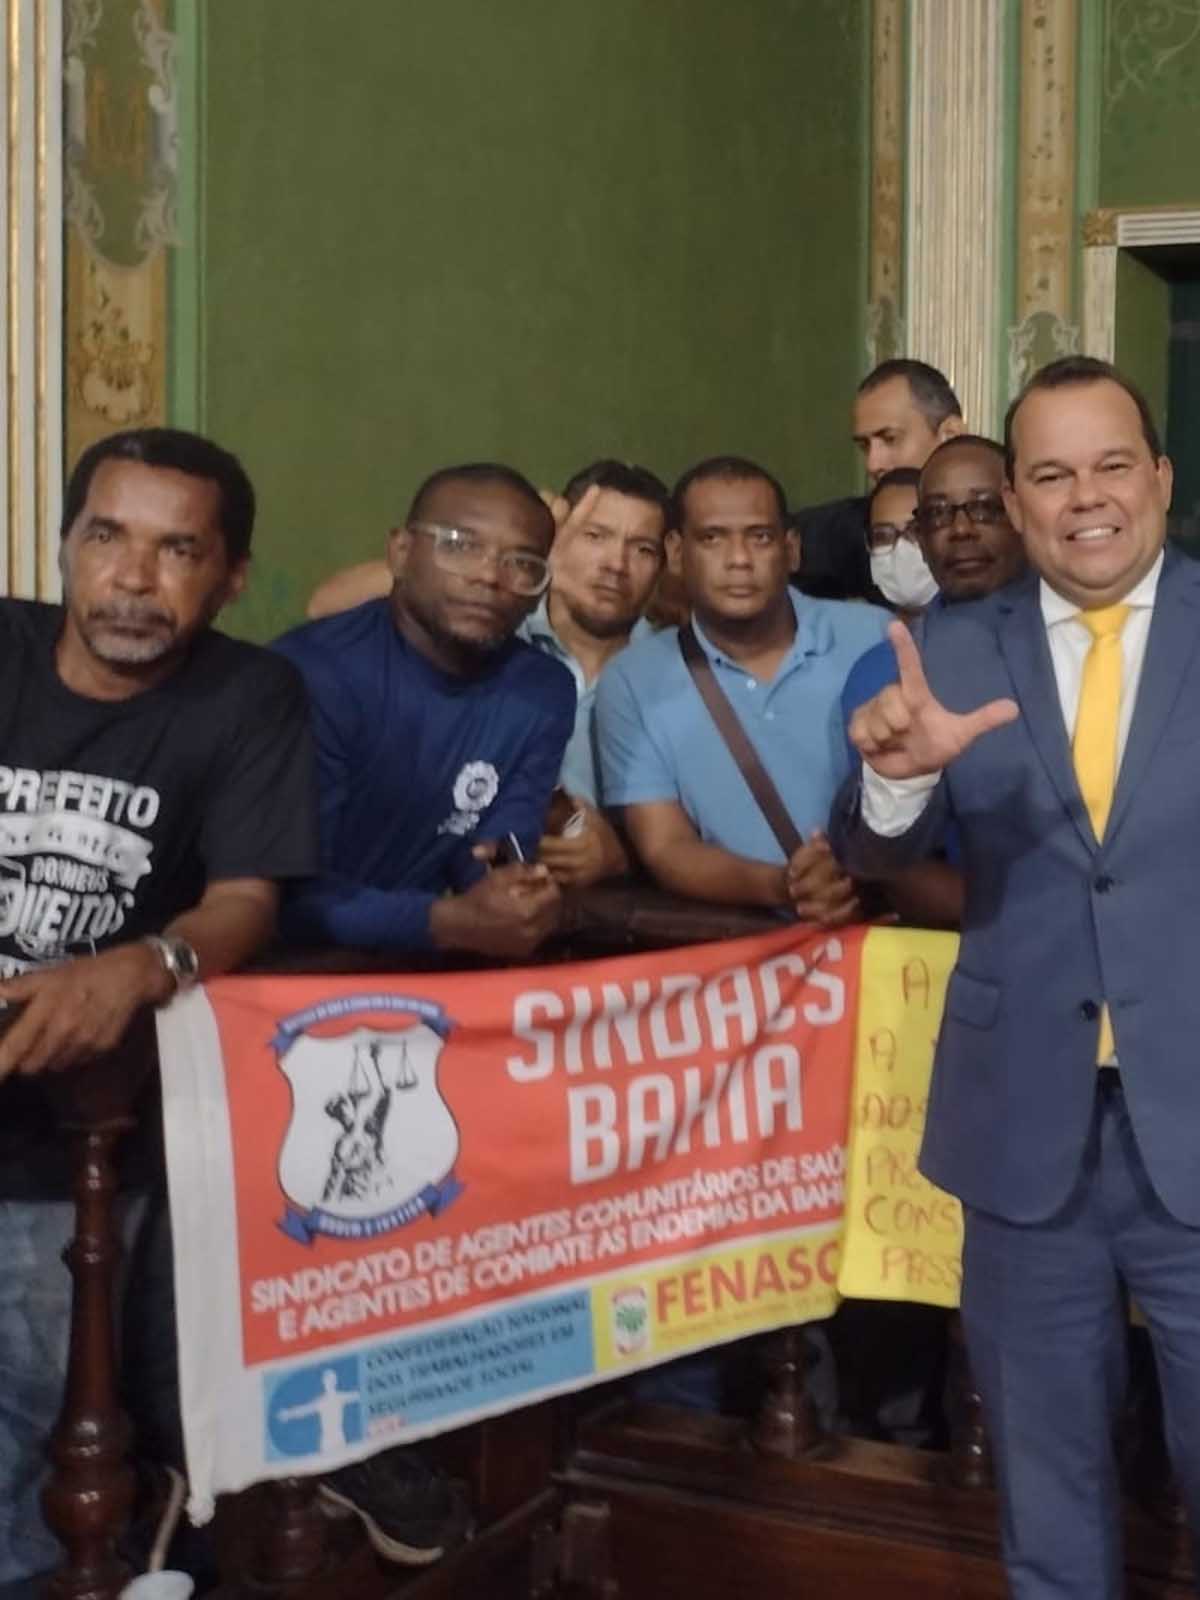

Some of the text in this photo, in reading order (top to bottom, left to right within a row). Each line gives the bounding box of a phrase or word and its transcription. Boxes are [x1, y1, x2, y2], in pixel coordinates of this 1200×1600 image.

[0, 766, 160, 828] PREFEITO
[506, 938, 846, 1083] SINDACS
[567, 1043, 803, 1185] BAHIA
[252, 1247, 411, 1313] SINDICATO
[414, 1237, 453, 1271] DE
[457, 1208, 572, 1261] AGENTES
[575, 1164, 759, 1231] COMUNITÁRIOS
[761, 1153, 797, 1189] DE
[278, 1307, 297, 1342] E
[302, 1276, 432, 1336] AGENTES
[433, 1265, 470, 1302] DE
[474, 1233, 595, 1291] COMBATE
[631, 1200, 750, 1250] ENDEMIAS
[752, 1190, 788, 1219] DA
